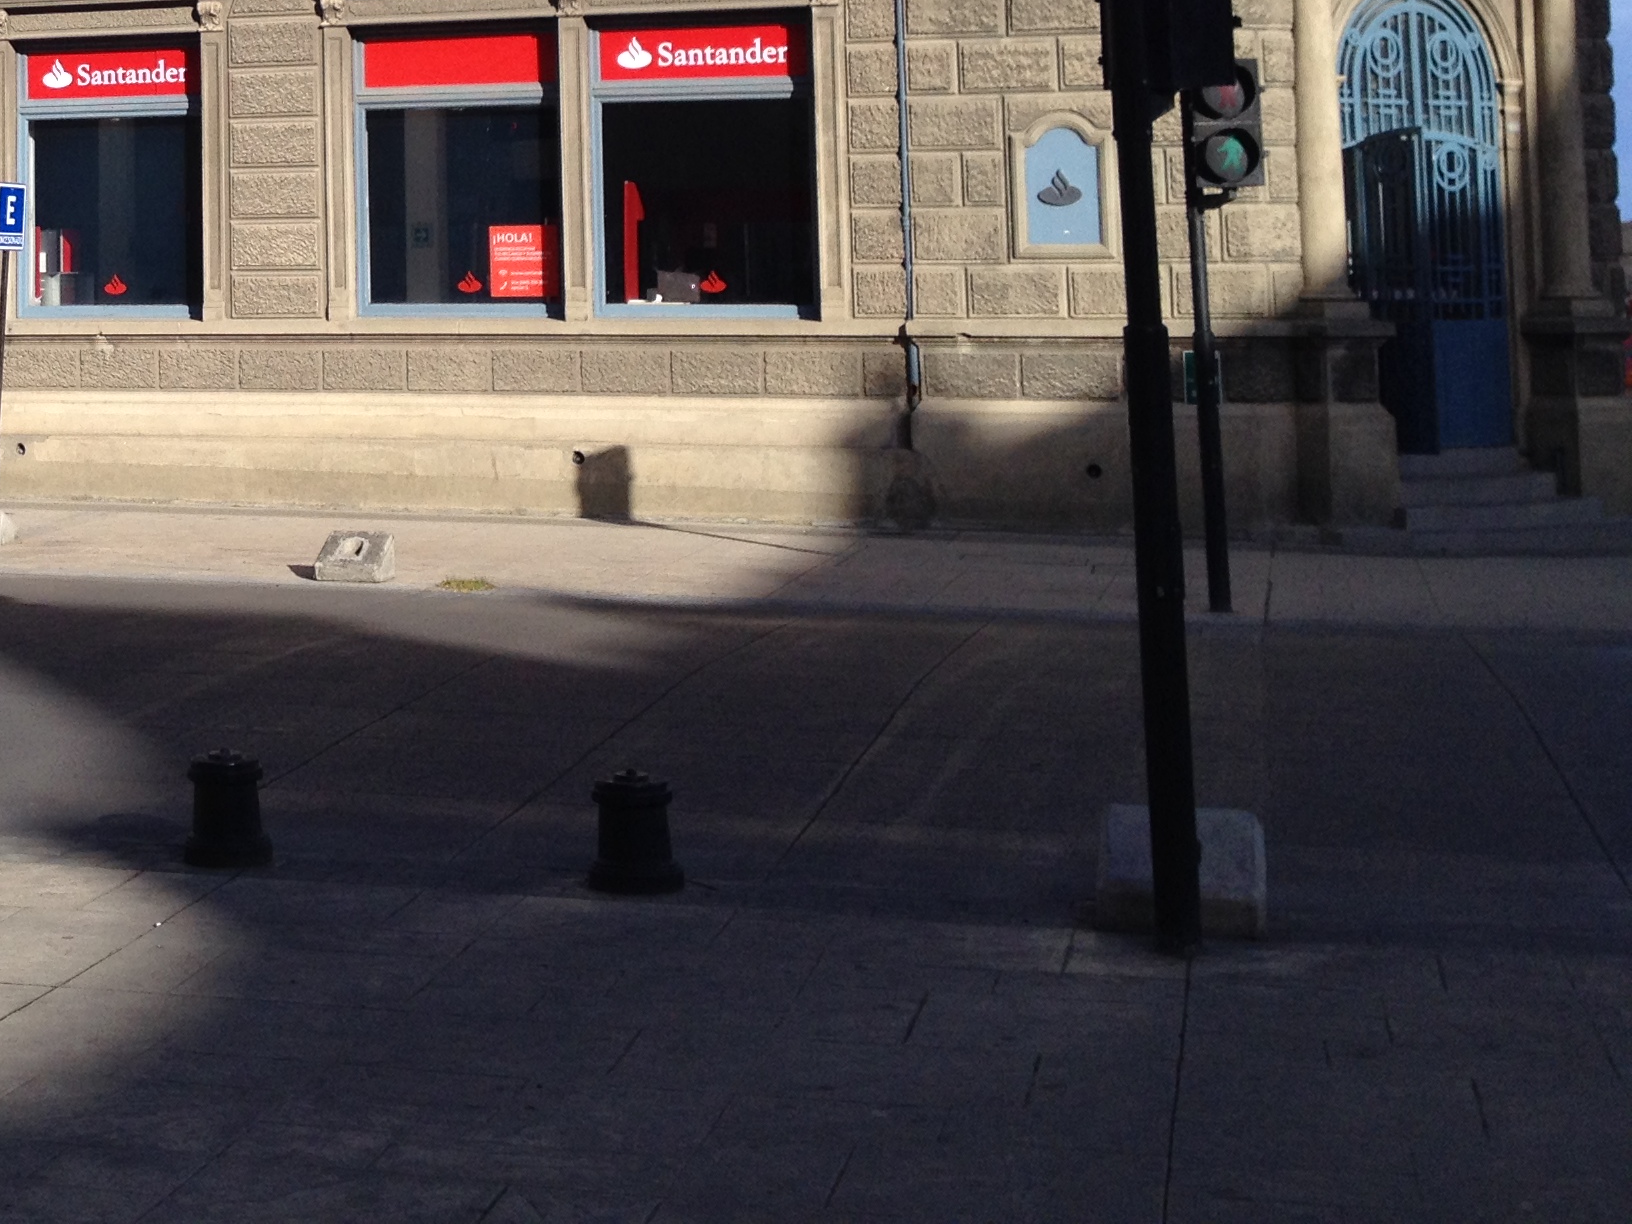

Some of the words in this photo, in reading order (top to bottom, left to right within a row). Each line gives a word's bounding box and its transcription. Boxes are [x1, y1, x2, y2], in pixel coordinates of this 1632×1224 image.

[657, 37, 788, 66] Santander
[77, 59, 186, 86] Santander
[6, 195, 17, 225] E
[493, 233, 532, 245] ¡HOLA!
